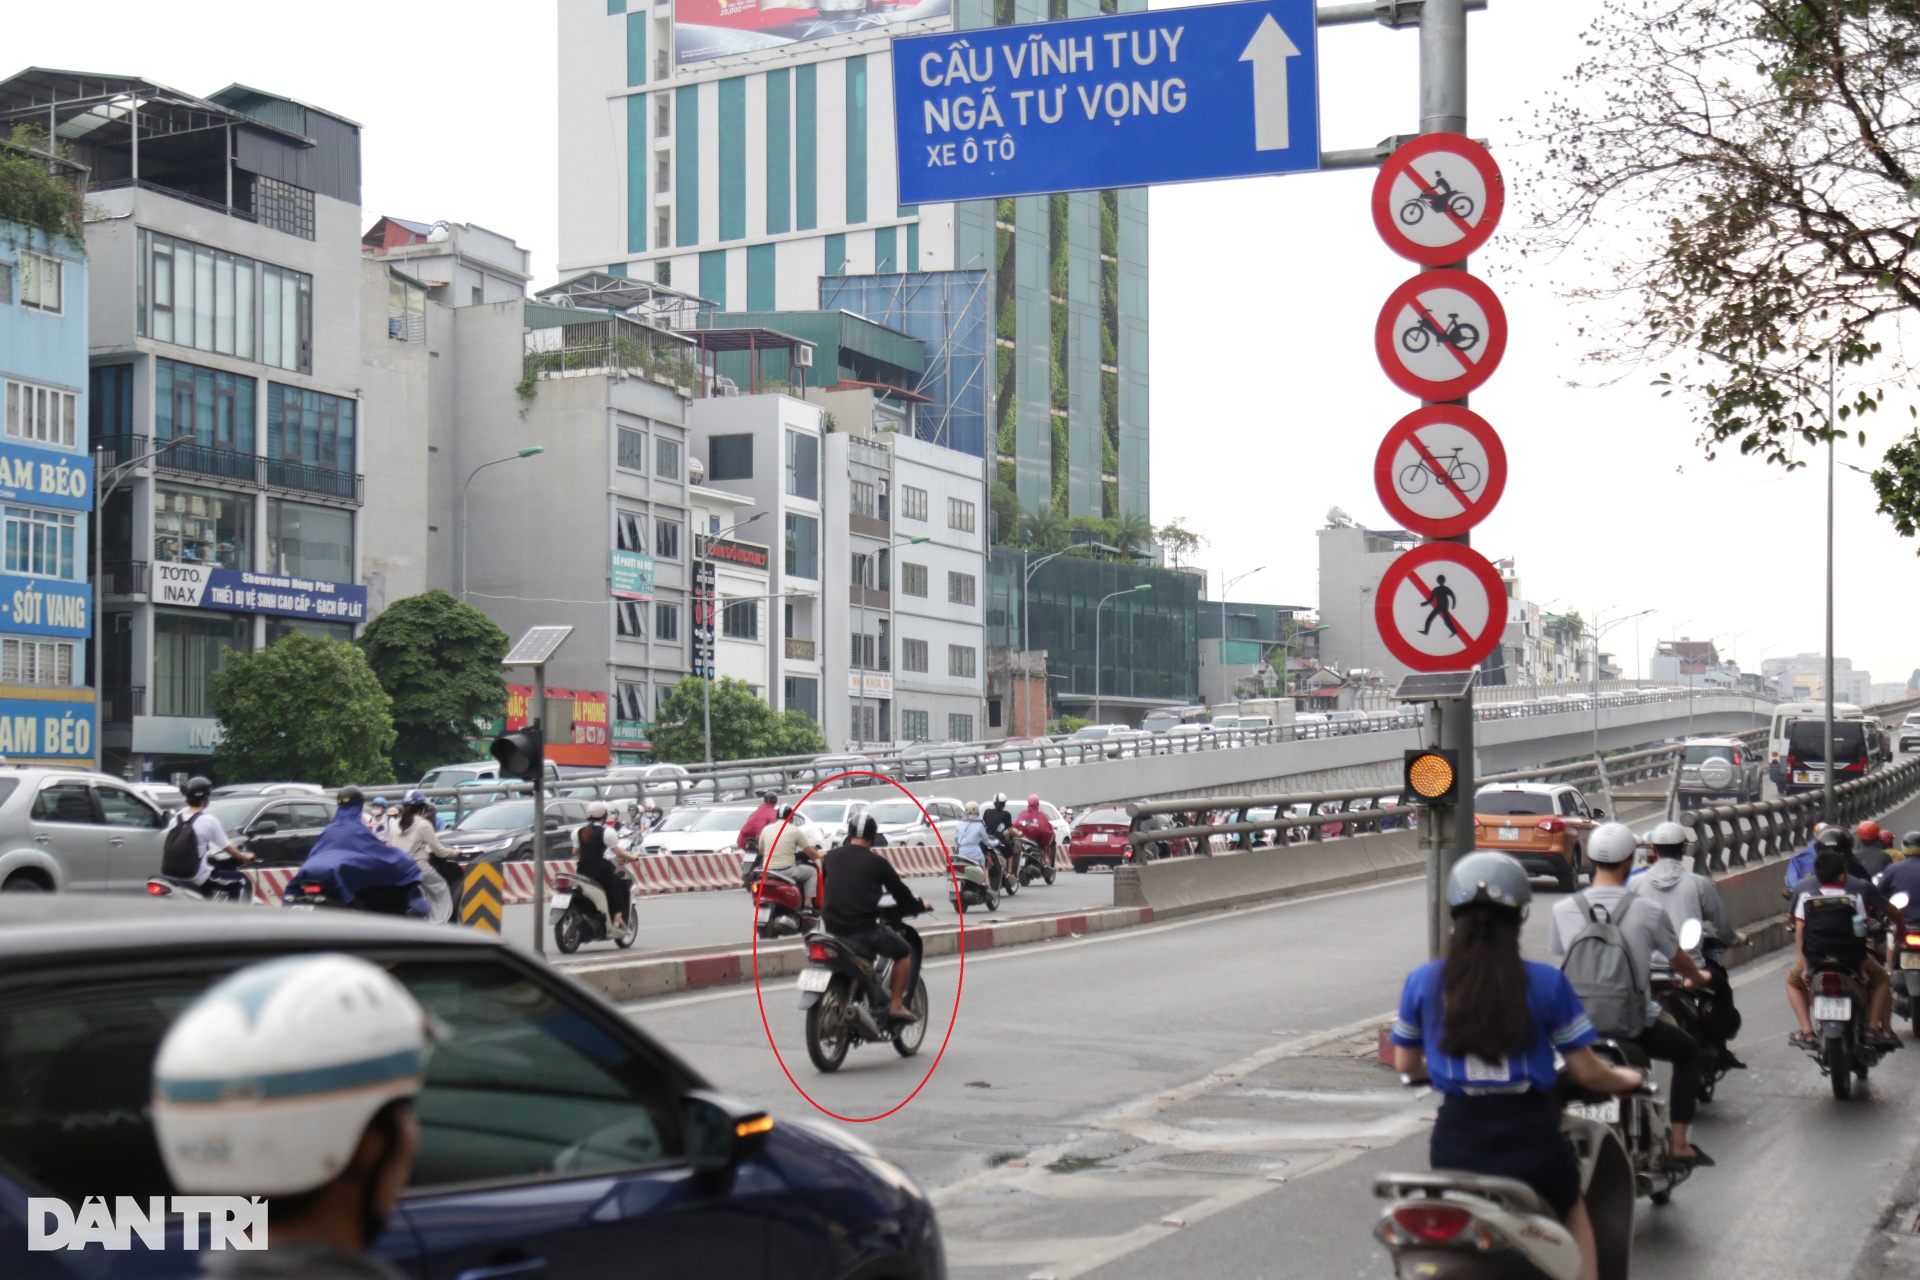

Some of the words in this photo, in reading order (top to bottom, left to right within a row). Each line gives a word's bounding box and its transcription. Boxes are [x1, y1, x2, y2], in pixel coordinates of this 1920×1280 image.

[720, 6, 742, 16] 20.000
[920, 39, 993, 87] CẦU
[1003, 34, 1094, 79] VĨNH
[1104, 26, 1185, 68] TUY
[924, 86, 1005, 135] NGÃ
[1011, 84, 1067, 126] TƯ
[1077, 78, 1187, 126] VỌNG
[926, 144, 957, 167] XE
[962, 137, 978, 163] Ô
[984, 133, 1015, 162] TÔ
[40, 458, 86, 498] BÉO
[160, 566, 201, 583] TOTO
[242, 572, 290, 588] Showroom
[315, 581, 335, 593] Phát
[13, 580, 43, 625] SỐT
[46, 593, 85, 629] VANG
[164, 585, 196, 603] INAX
[235, 590, 244, 608] BỊ
[245, 589, 256, 609] VỆ
[257, 592, 277, 609] SINH
[277, 594, 293, 611] CAO
[294, 593, 311, 612] CẤP
[316, 599, 337, 617] GẠCH
[337, 597, 348, 616] ỐP
[348, 600, 363, 618] LÁT
[852, 676, 863, 688] NH
[508, 690, 524, 722] ĐẶC
[582, 696, 606, 723] PHÒNG
[44, 710, 90, 755] BÉO
[188, 727, 224, 749] INA
